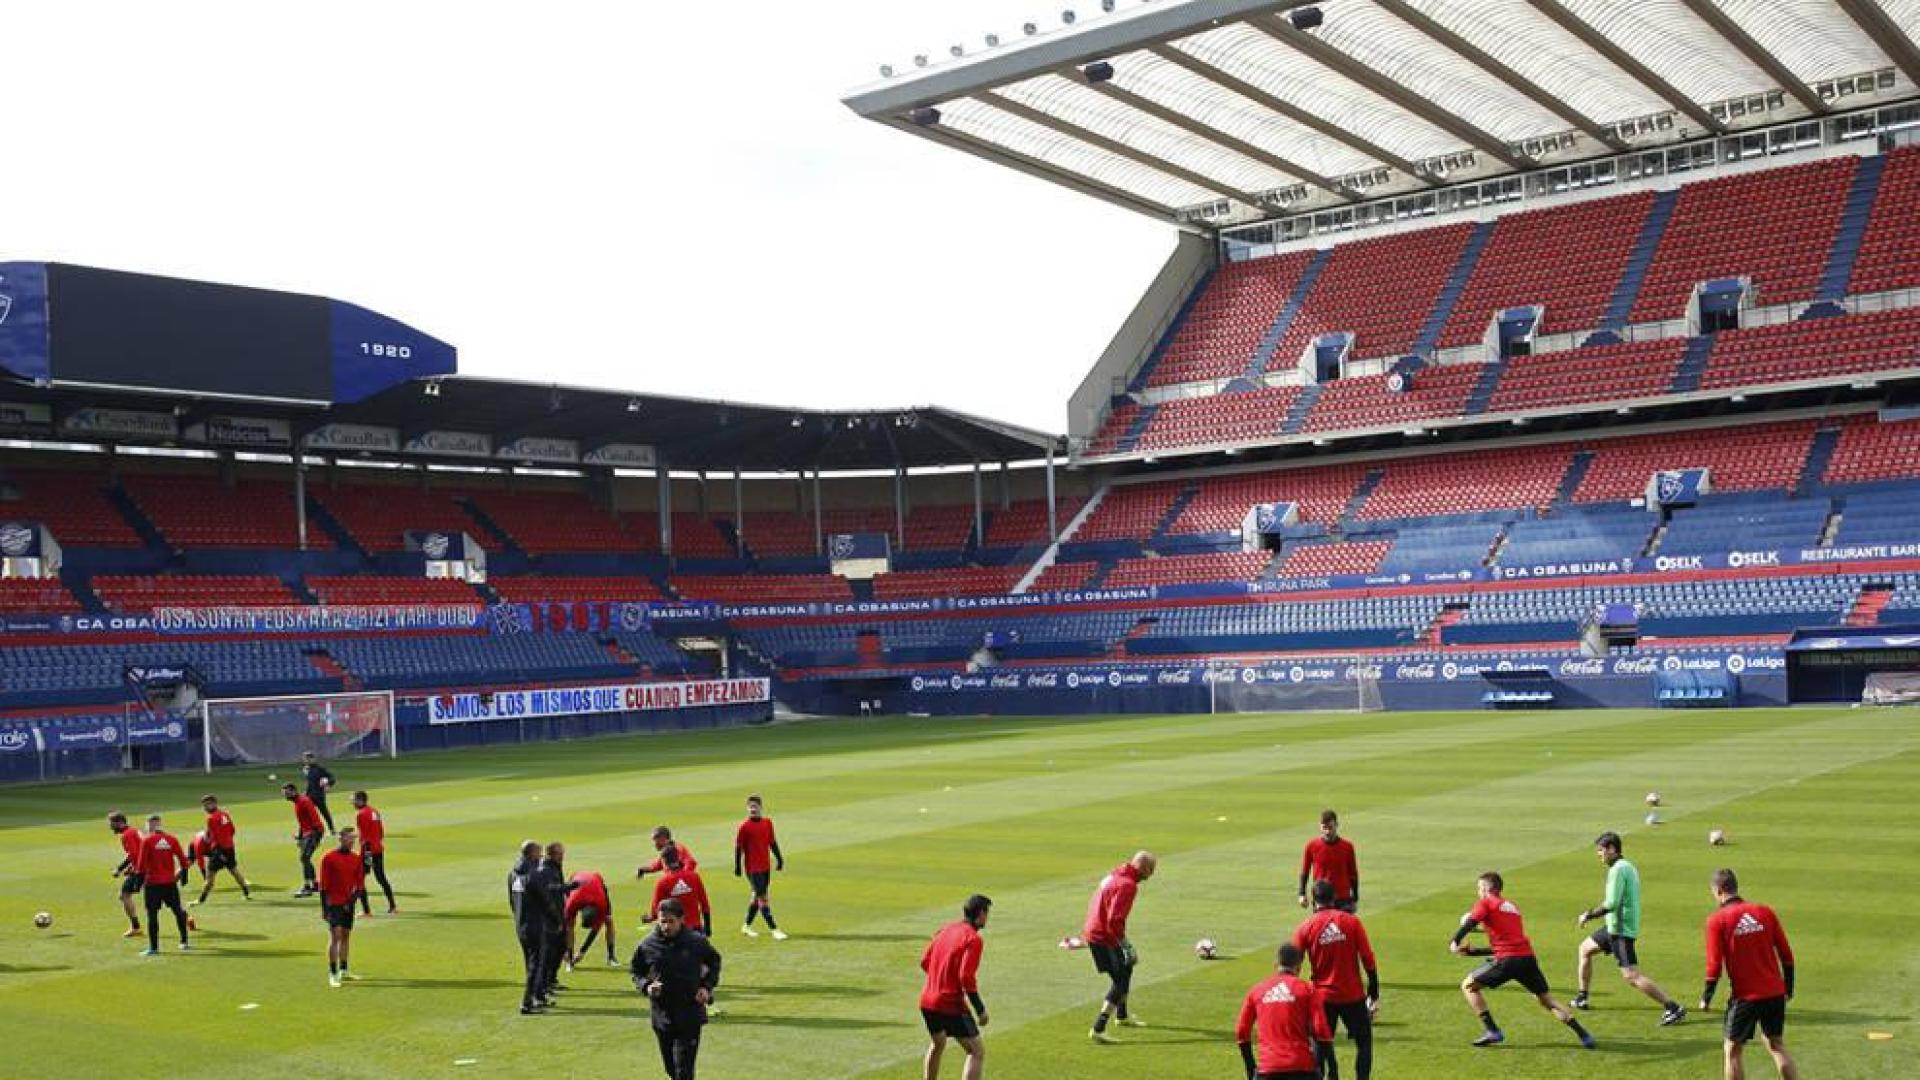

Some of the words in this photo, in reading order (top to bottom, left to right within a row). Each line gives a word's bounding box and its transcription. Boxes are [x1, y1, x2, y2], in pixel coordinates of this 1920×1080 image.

[360, 342, 411, 359] 1920
[1534, 562, 1618, 575] OSASUNA
[981, 595, 1040, 606] OSASUNA
[1086, 590, 1149, 600] OSASUNA
[743, 605, 806, 616] OSASUNA
[859, 601, 930, 612] OSASUNA
[77, 618, 104, 630] CA
[1683, 658, 1720, 669] LaLiga
[1746, 656, 1785, 669] LaLiga
[435, 697, 490, 720] SOMOS
[495, 691, 525, 716] LOS
[531, 688, 592, 715] MISMOS
[593, 684, 620, 711] QUE
[625, 686, 680, 709] CUANDO
[685, 680, 765, 704] EMPEZAMOS
